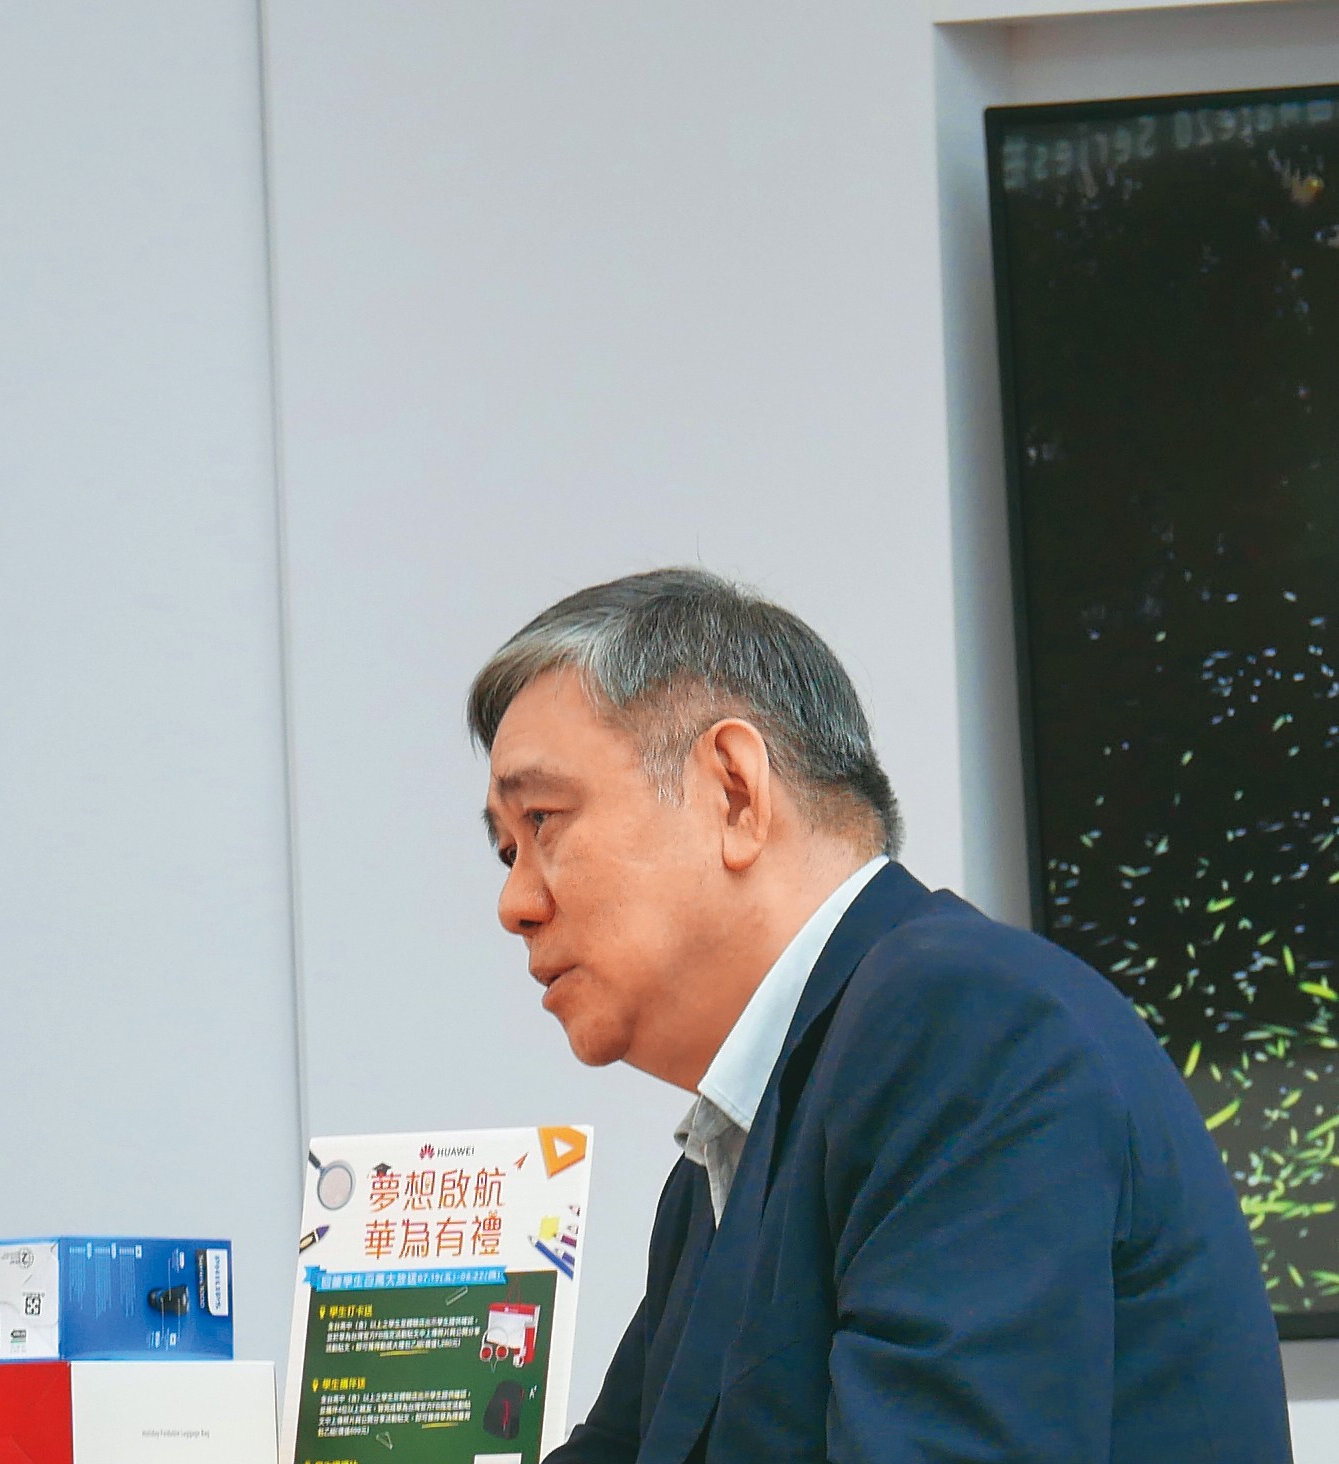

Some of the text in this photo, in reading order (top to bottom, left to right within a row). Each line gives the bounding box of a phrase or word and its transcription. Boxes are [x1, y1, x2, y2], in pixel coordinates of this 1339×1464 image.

[437, 1147, 475, 1157] HUAWEI
[369, 1167, 507, 1212] 夢想啟航
[365, 1214, 502, 1259] 華為有禮
